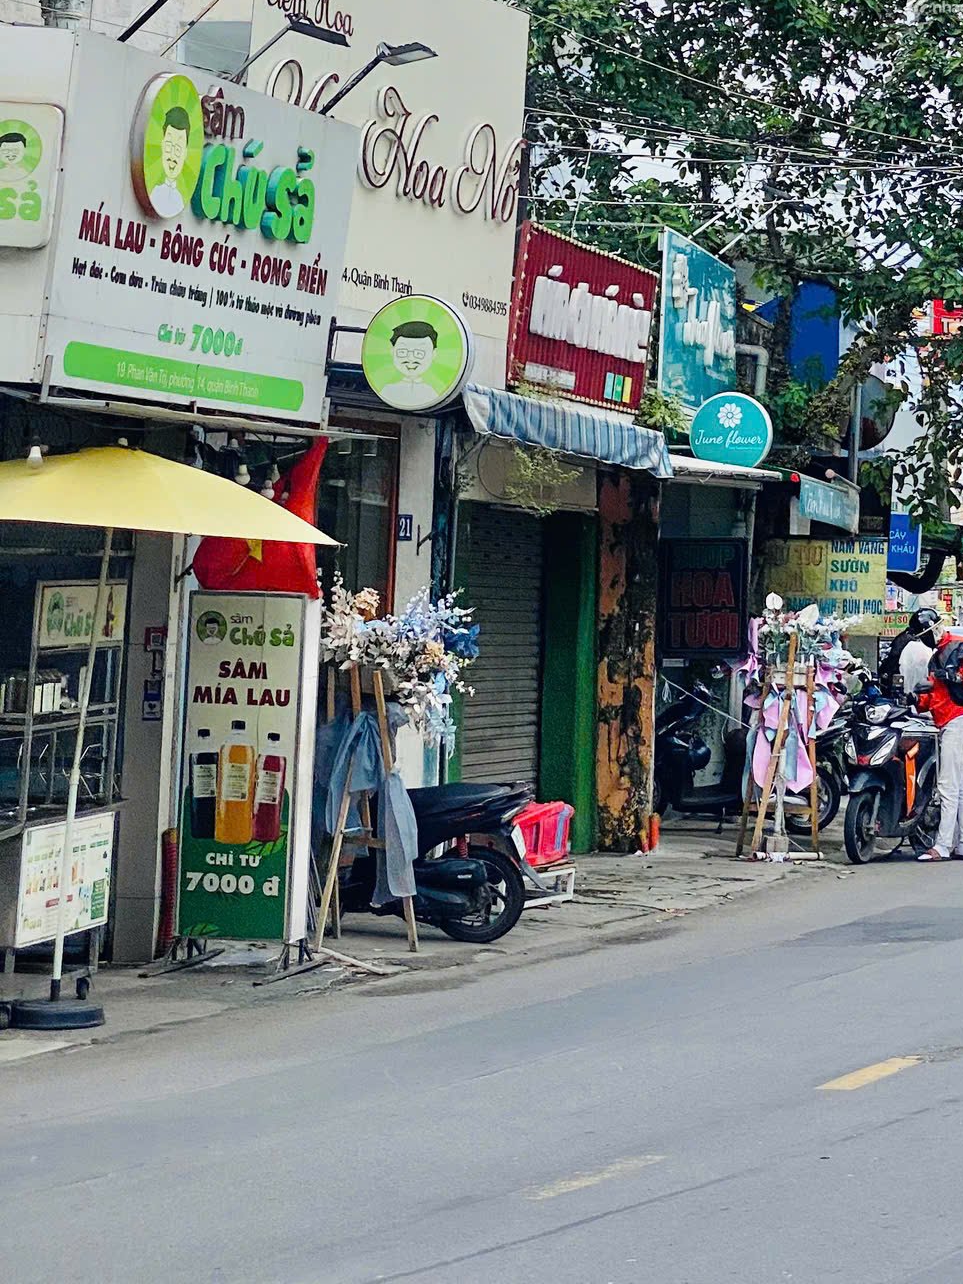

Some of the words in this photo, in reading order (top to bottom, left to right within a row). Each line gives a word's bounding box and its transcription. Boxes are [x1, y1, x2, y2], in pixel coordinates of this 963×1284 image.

[359, 85, 447, 208] Hoa
[79, 201, 111, 247] MÍA
[114, 218, 147, 254] LAU
[160, 223, 204, 268] BÔNG
[209, 234, 237, 276] CÚC
[250, 252, 293, 288] RONG
[296, 252, 328, 296] BIỂN
[695, 429, 724, 445] June
[725, 429, 763, 448] flower
[399, 517, 411, 537] 21
[229, 625, 266, 647] Chú
[218, 657, 268, 680] SÂM
[193, 683, 238, 705] MÍA
[246, 688, 290, 707] LAU
[186, 871, 255, 895] 7000
[262, 875, 281, 897] đ
